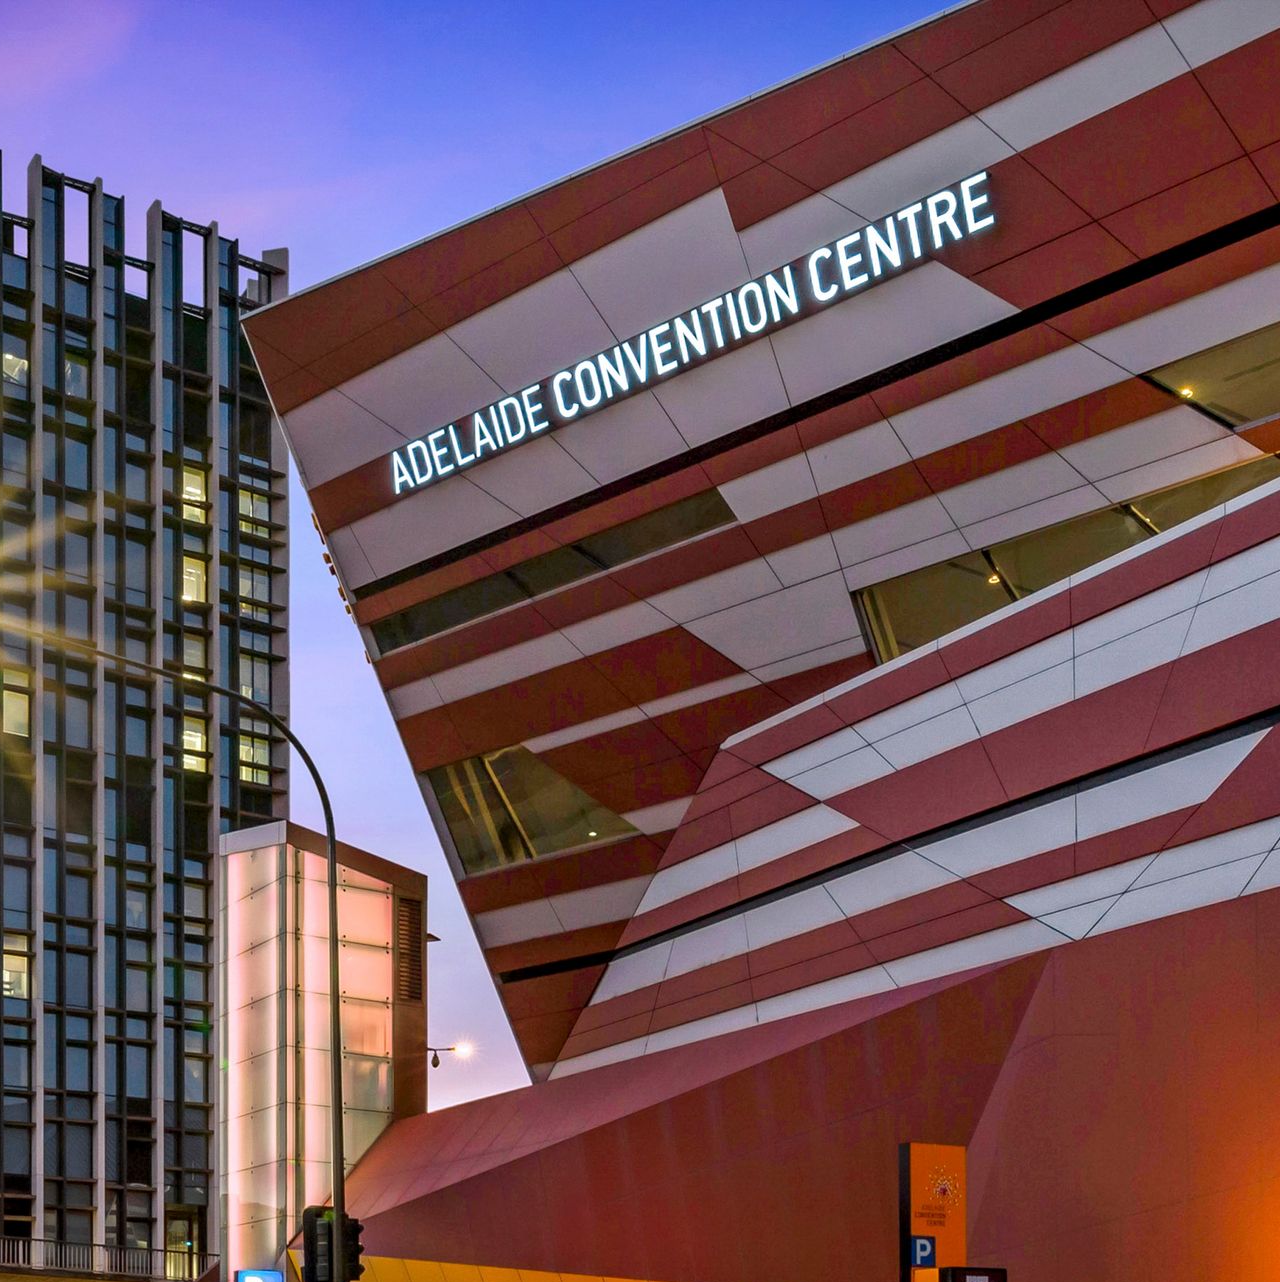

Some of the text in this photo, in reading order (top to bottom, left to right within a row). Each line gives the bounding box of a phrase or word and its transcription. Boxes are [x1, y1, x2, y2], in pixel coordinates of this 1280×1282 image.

[391, 170, 995, 495] ADELAIDE CONVENTION CENTRE
[916, 1239, 931, 1264] P
